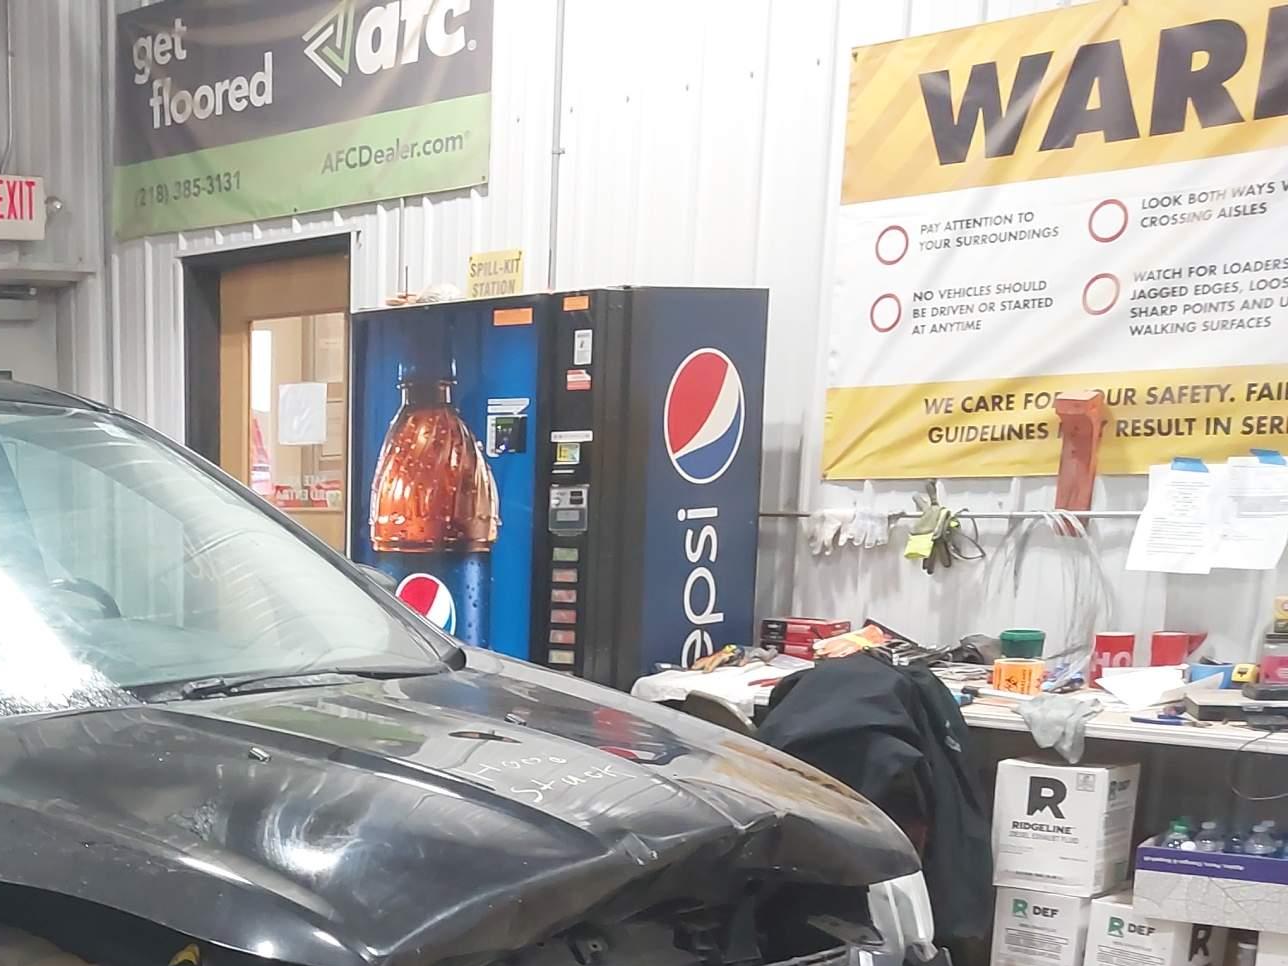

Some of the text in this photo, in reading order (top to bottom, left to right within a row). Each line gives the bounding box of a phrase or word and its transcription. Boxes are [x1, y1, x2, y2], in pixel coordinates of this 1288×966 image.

[132, 18, 187, 85] get
[149, 51, 273, 129] floored
[321, 133, 464, 175] AFCDealer.com
[134, 170, 241, 207] (218) 385-3131
[1141, 194, 1183, 210] LOOK
[1188, 190, 1227, 205] BOTH
[1231, 181, 1276, 198] WAYS
[920, 211, 1035, 235] PAY ATTENTION TO
[1140, 202, 1268, 228] CROSSING AISLES
[919, 226, 1060, 252] YOUR SURROUNDINGS
[470, 258, 520, 278] SPILL-KIT
[1133, 267, 1183, 283] WATCH
[1187, 264, 1217, 278] FOR
[472, 280, 516, 298] STATION
[912, 280, 1048, 303] NO VEHICLES SHOULD
[1129, 286, 1189, 301] JAGGED
[1193, 280, 1244, 296] EDGES,
[912, 297, 1054, 319] BE DRIVEN OR STARTED
[1129, 304, 1178, 319] SHARP
[1182, 300, 1236, 316] POINTS
[1240, 298, 1274, 312] AND
[911, 319, 982, 336] AT ANYTIME
[1129, 315, 1272, 337] WALKING SURFACES
[924, 398, 954, 415] WE
[961, 394, 1016, 413] CARE
[1023, 391, 1063, 410] FO
[1145, 383, 1236, 406] SAFETY.
[927, 422, 1050, 444] GUIDELINES
[1115, 417, 1197, 438] RESULT
[1205, 416, 1232, 436] IN
[1027, 776, 1067, 819] R
[1012, 820, 1073, 835] RIDGELINE
[1032, 905, 1059, 919] DEF
[1127, 922, 1157, 937] DEF
